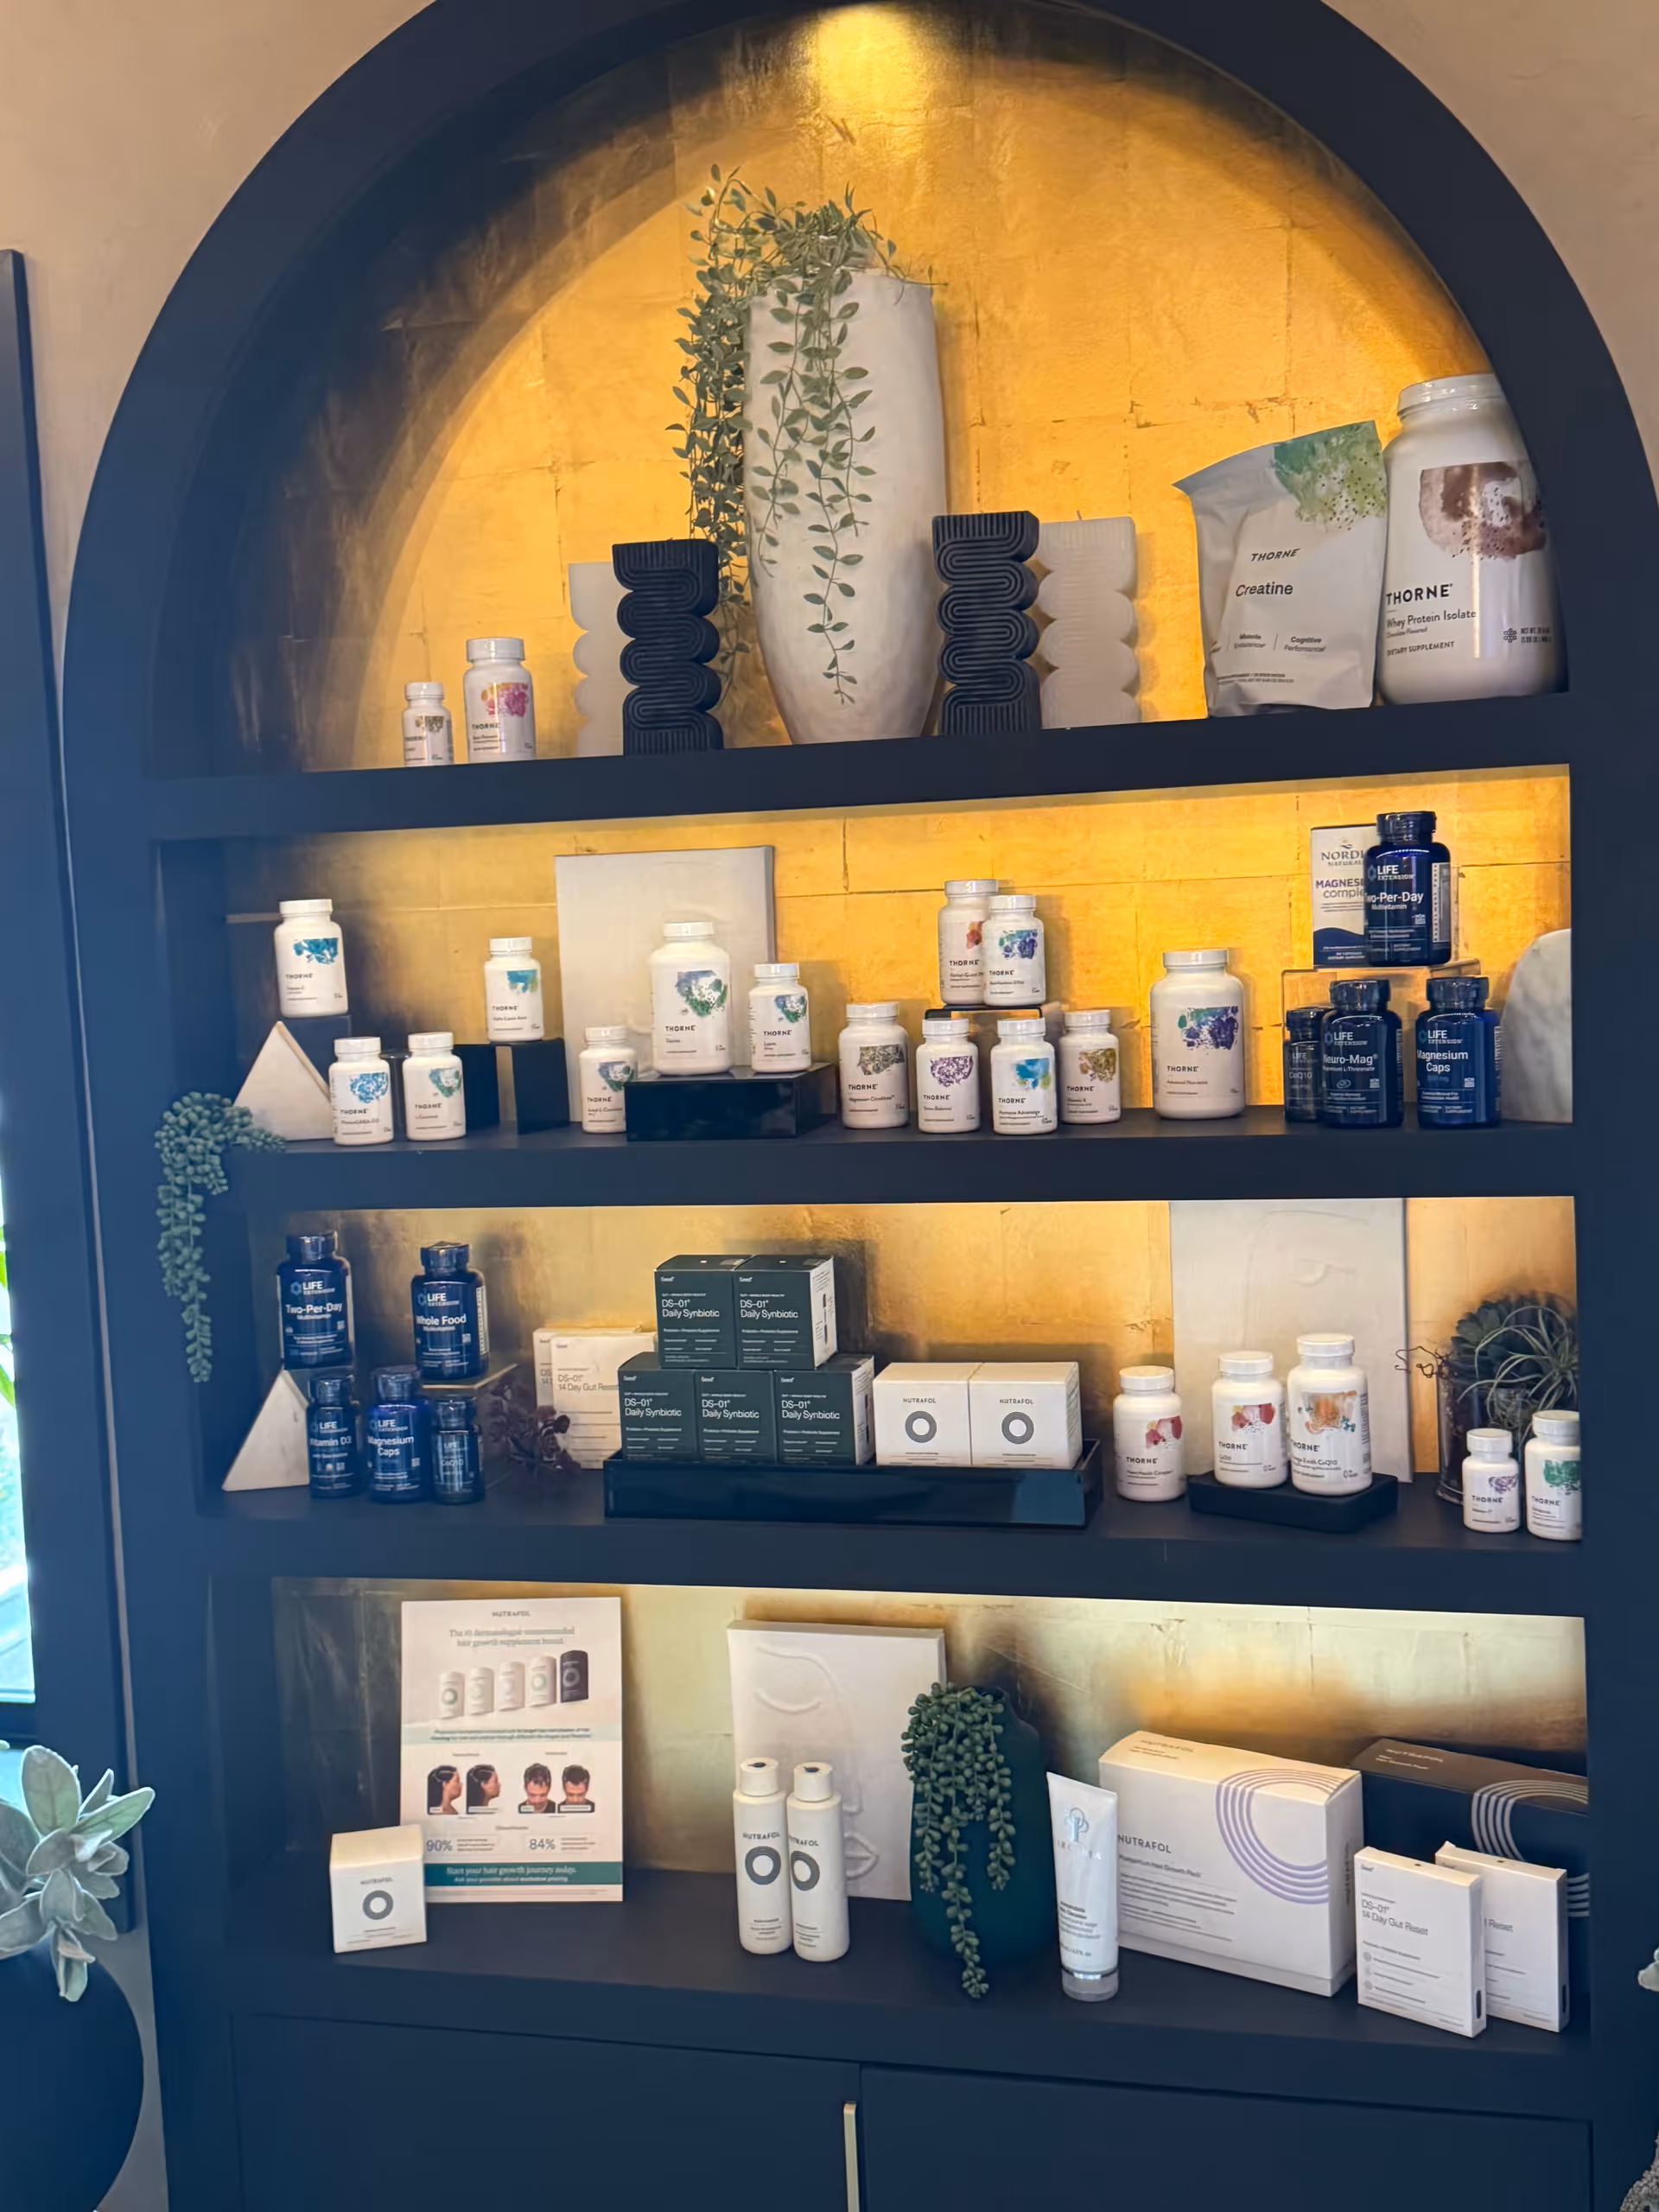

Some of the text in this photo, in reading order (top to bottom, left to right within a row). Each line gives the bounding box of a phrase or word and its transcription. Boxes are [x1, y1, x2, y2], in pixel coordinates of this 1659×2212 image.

[1251, 549, 1299, 562] THORNE
[1236, 582, 1294, 597] Creatine
[1386, 583, 1452, 606] THORNE
[1387, 609, 1477, 629] Whey Protein Isolate
[1408, 641, 1455, 652] SUPPLEMENT
[1377, 865, 1399, 874] LIFE
[1334, 1032, 1354, 1040] LIFE
[1427, 1030, 1448, 1039] LIFE
[1417, 1050, 1469, 1061] Magnesium
[1426, 1062, 1451, 1074] Caps
[302, 1281, 323, 1290] LIFE
[427, 1293, 447, 1302] LIFE
[285, 1302, 342, 1313] Two-Per-Day
[416, 1313, 467, 1325] Whole Food
[663, 1309, 720, 1319] Daily Synbiotic
[741, 1310, 798, 1319] Daily Synbiotic
[625, 1408, 682, 1418] Daily Synbiotic
[702, 1409, 760, 1420] Daily Synbiotic
[782, 1410, 840, 1421] Daily Synbiotic
[367, 1436, 414, 1446] Magnesium
[1218, 1441, 1248, 1450] THORNE
[378, 1447, 400, 1457] Caps
[1532, 1496, 1560, 1506] THORNE
[426, 1840, 453, 1852] 90%
[529, 1839, 555, 1851] 84%
[1117, 1834, 1172, 1853] NUTRAFOL
[447, 1866, 464, 1875] Start
[499, 1867, 524, 1876] growth
[526, 1866, 554, 1875] journey
[1371, 1912, 1388, 1926] Day
[1389, 1917, 1404, 1929] Gut
